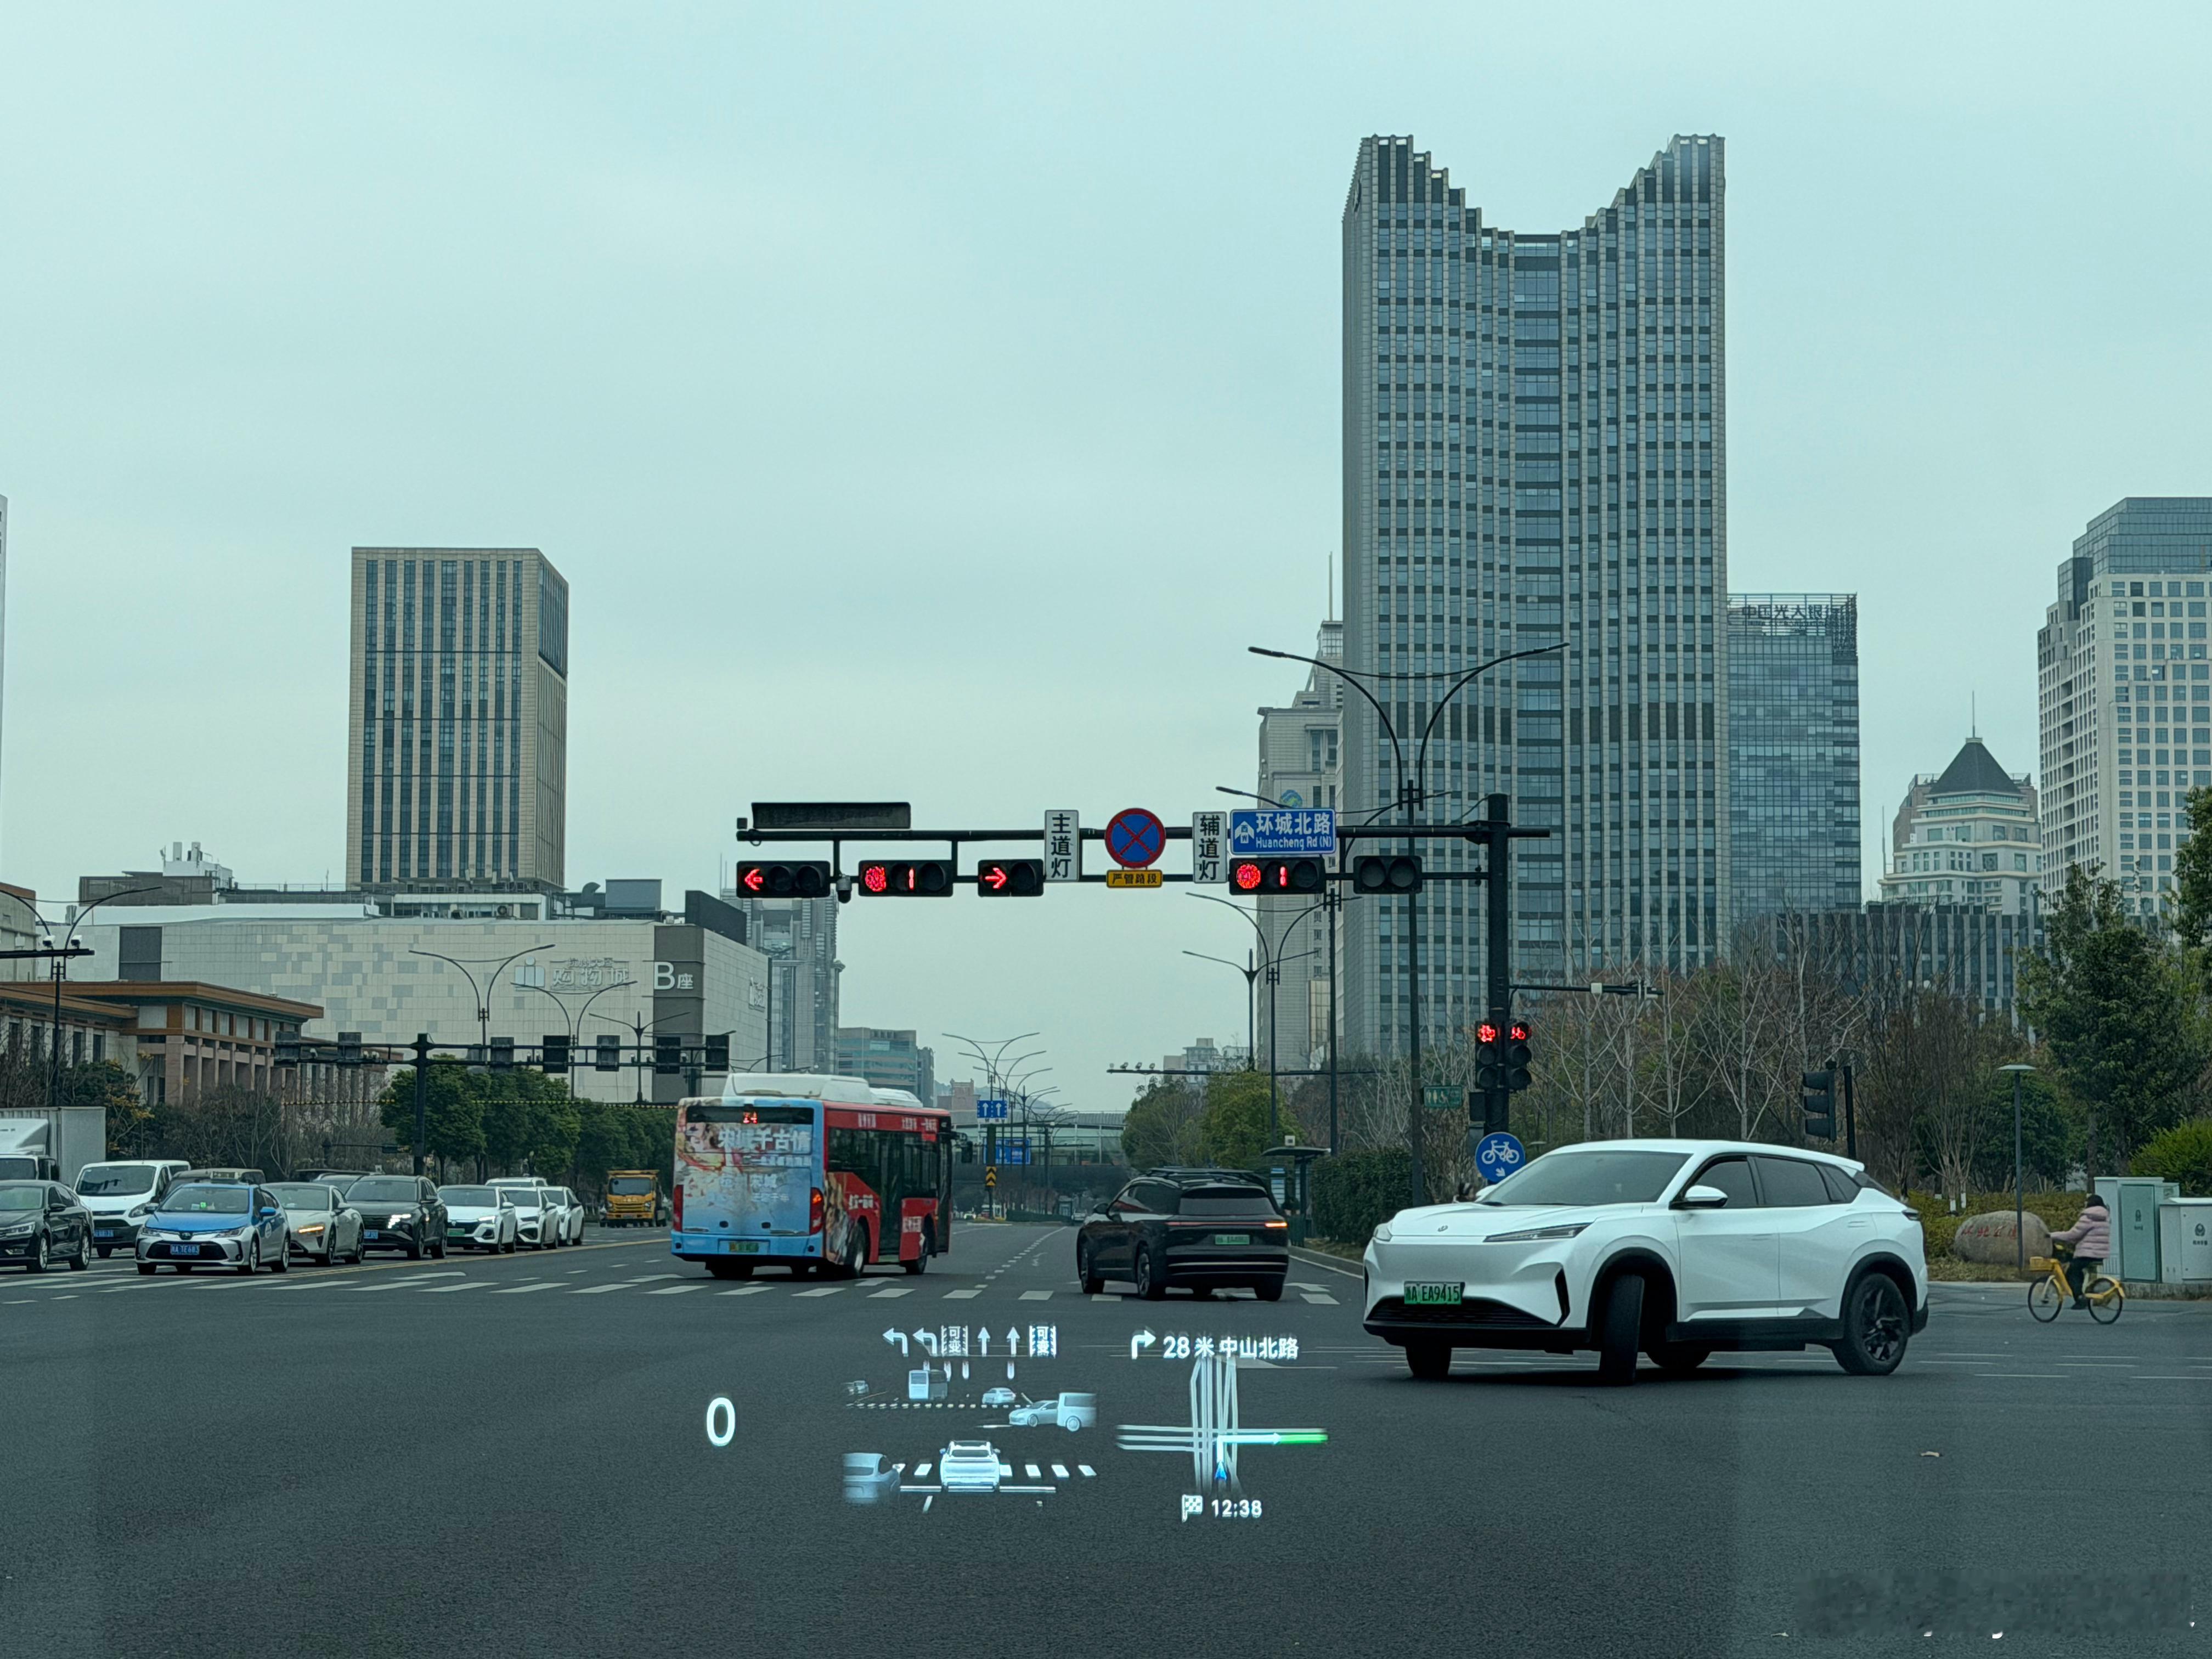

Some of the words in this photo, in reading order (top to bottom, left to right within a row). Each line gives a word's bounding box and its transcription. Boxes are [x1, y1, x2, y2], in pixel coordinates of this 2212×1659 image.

[1256, 812, 1331, 836] 环城北路
[1051, 813, 1071, 878] 主道灯
[1199, 815, 1220, 881] 辅道灯
[1256, 837, 1304, 850] Huancheng
[1306, 836, 1318, 848] Rd
[1319, 836, 1332, 848] (N)
[1112, 873, 1158, 884] 严管路段
[553, 968, 629, 986] 购物城
[654, 961, 694, 990] B座
[1422, 1284, 1460, 1301] EA9415
[949, 1325, 961, 1353] 可变
[1036, 1325, 1049, 1355] 可变
[1163, 1336, 1190, 1359] 28
[1195, 1335, 1215, 1358] 米
[1220, 1335, 1299, 1360] 中山北路
[707, 1397, 735, 1447] 0
[1211, 1499, 1262, 1519] 12:38
